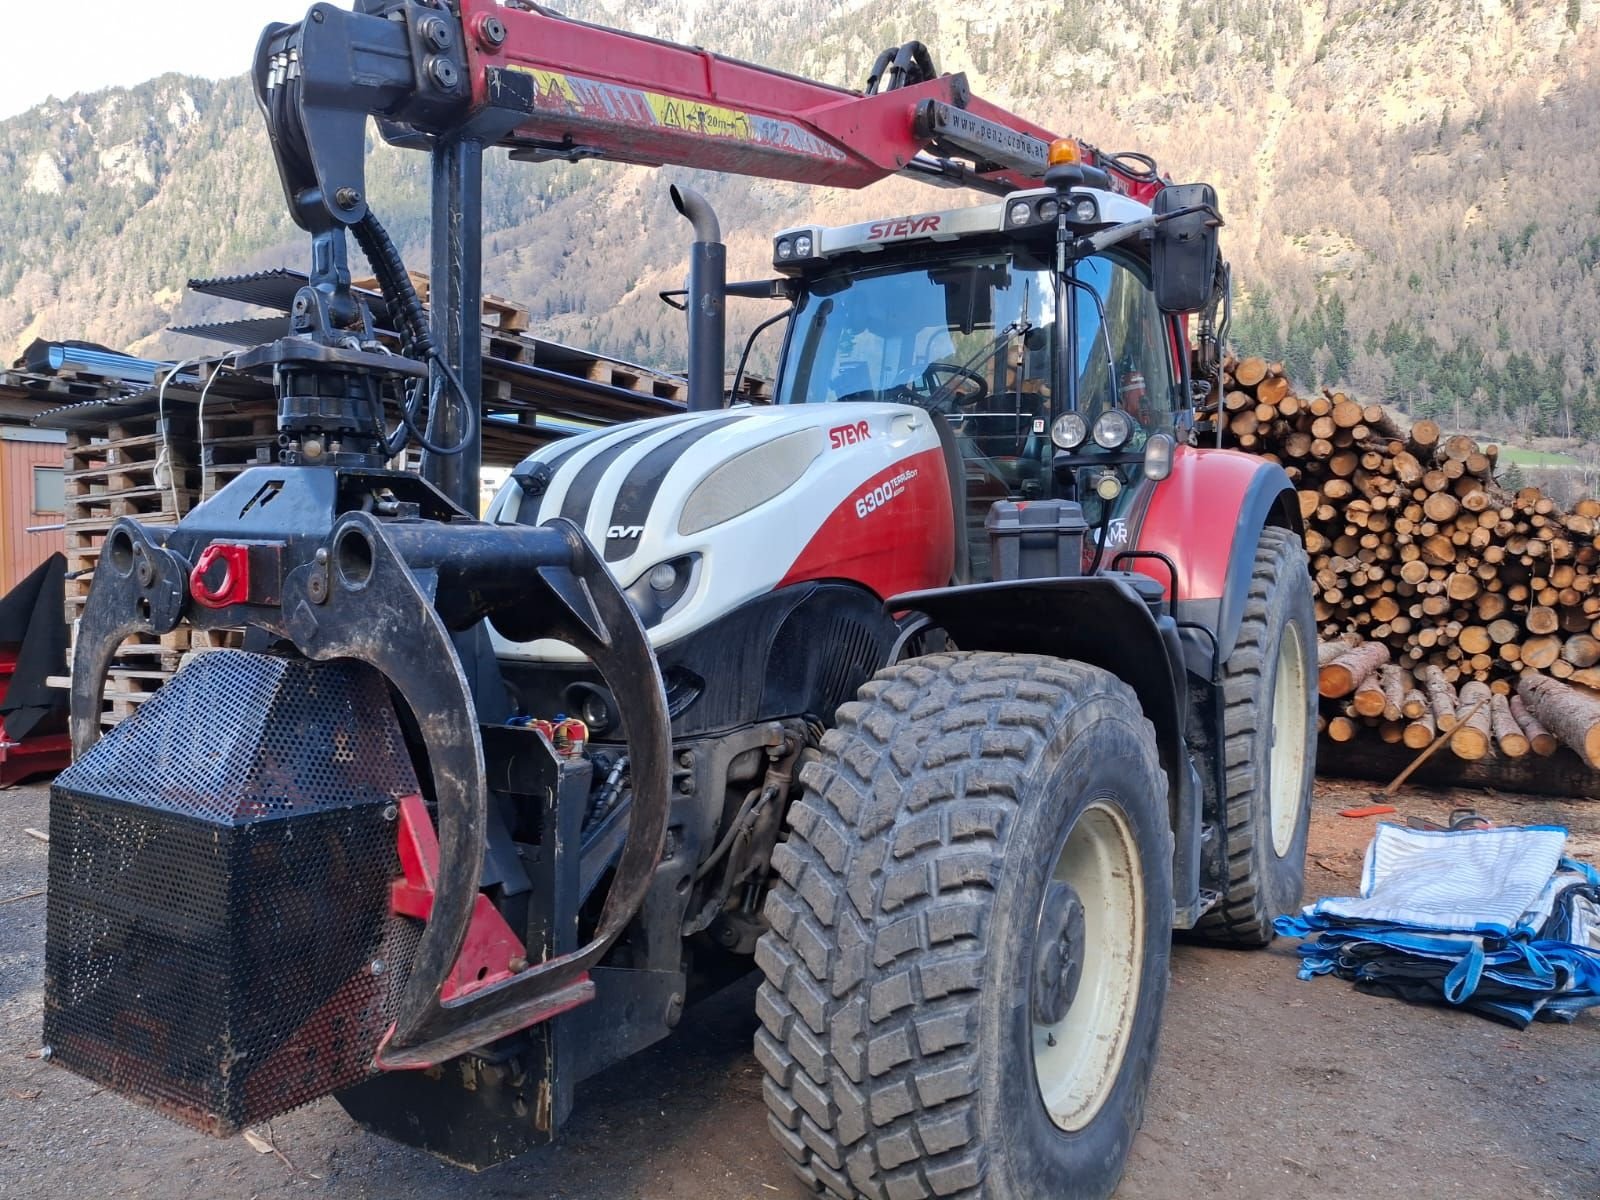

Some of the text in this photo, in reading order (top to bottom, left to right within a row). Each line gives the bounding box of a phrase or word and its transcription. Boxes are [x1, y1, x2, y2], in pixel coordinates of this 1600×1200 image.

[952, 114, 1044, 158] www.penz-crane.at
[867, 215, 941, 240] STEYR
[829, 420, 872, 450] STEYR
[855, 481, 893, 519] 6300
[606, 525, 644, 538] CVT
